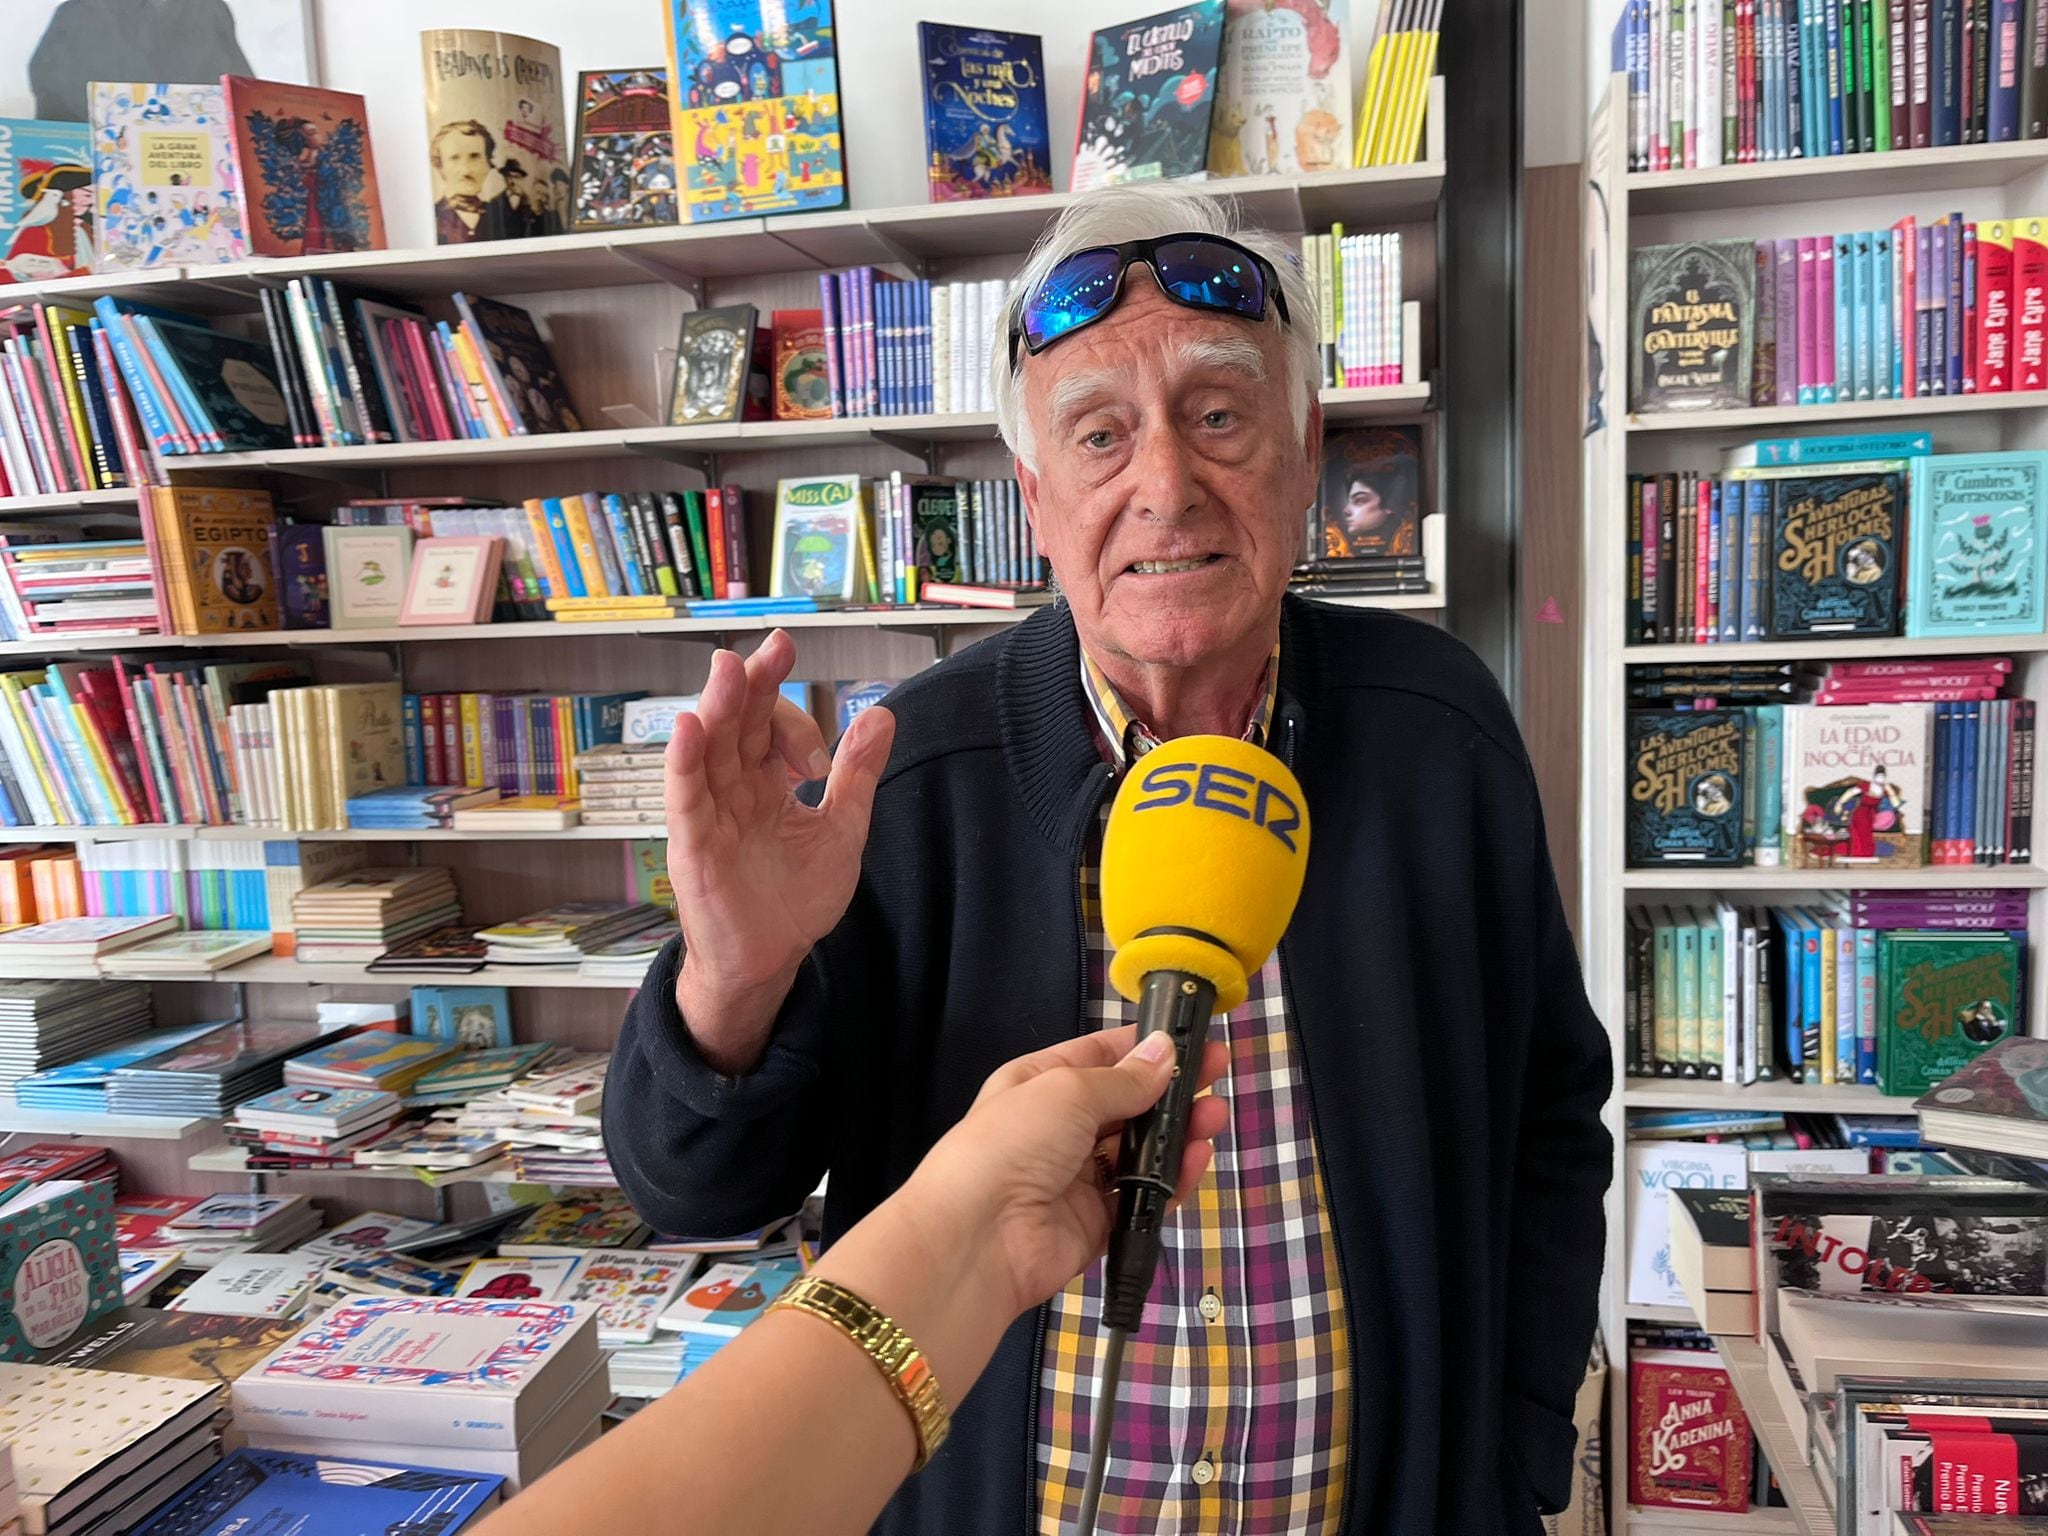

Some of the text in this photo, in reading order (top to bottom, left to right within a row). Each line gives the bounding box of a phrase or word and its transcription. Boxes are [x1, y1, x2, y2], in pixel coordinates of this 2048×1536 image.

[1670, 36, 1683, 80] ZWEIG
[1706, 23, 1717, 67] ZWEIG
[1724, 32, 1735, 75] ZWEIG
[1787, 23, 1799, 67] ZWEIG
[147, 151, 203, 161] AVENTURA
[169, 143, 198, 151] GRAN
[149, 160, 203, 169] DEL LIBRO
[1652, 302, 1738, 326] FANTASMA
[2020, 287, 2046, 367] Jane Eyre
[1644, 328, 1739, 354] CANTERVILLE
[1984, 290, 2009, 369] Jane Eyre
[1954, 474, 2014, 490] Cumbres
[1788, 498, 1815, 520] LAS
[1807, 486, 1889, 524] AVENTURAS
[1943, 490, 2026, 504] Borrascosas
[194, 527, 268, 542] EGIPTO
[1778, 503, 1888, 572] SHERLOCK
[1643, 546, 1656, 613] PETER PAN
[1920, 690, 1963, 701] WOOLF
[1928, 675, 1971, 687] WOOLF
[1640, 732, 1668, 750] LAS
[1662, 721, 1736, 753] AVENTURAS
[1820, 726, 1902, 745] LA EDAD
[1632, 737, 1732, 801] SHERLOCK
[1804, 750, 1916, 768] INOCENCIA
[1133, 762, 1302, 855] SER
[1954, 902, 1997, 914] WOOLF
[1954, 916, 1997, 928] WOOLF
[1639, 1170, 1738, 1188] WOOLF
[1662, 1159, 1713, 1172] VIRGINIA
[68, 1319, 136, 1360] WELLS
[378, 1339, 415, 1364] Dante
[397, 1332, 441, 1365] Alighieri
[1660, 1398, 1713, 1432] ANNA
[1650, 1419, 1736, 1477] KARENINA
[1939, 1462, 1952, 1500] Premio
[1955, 1464, 1968, 1503] Premio
[1971, 1474, 1985, 1513] Premio
